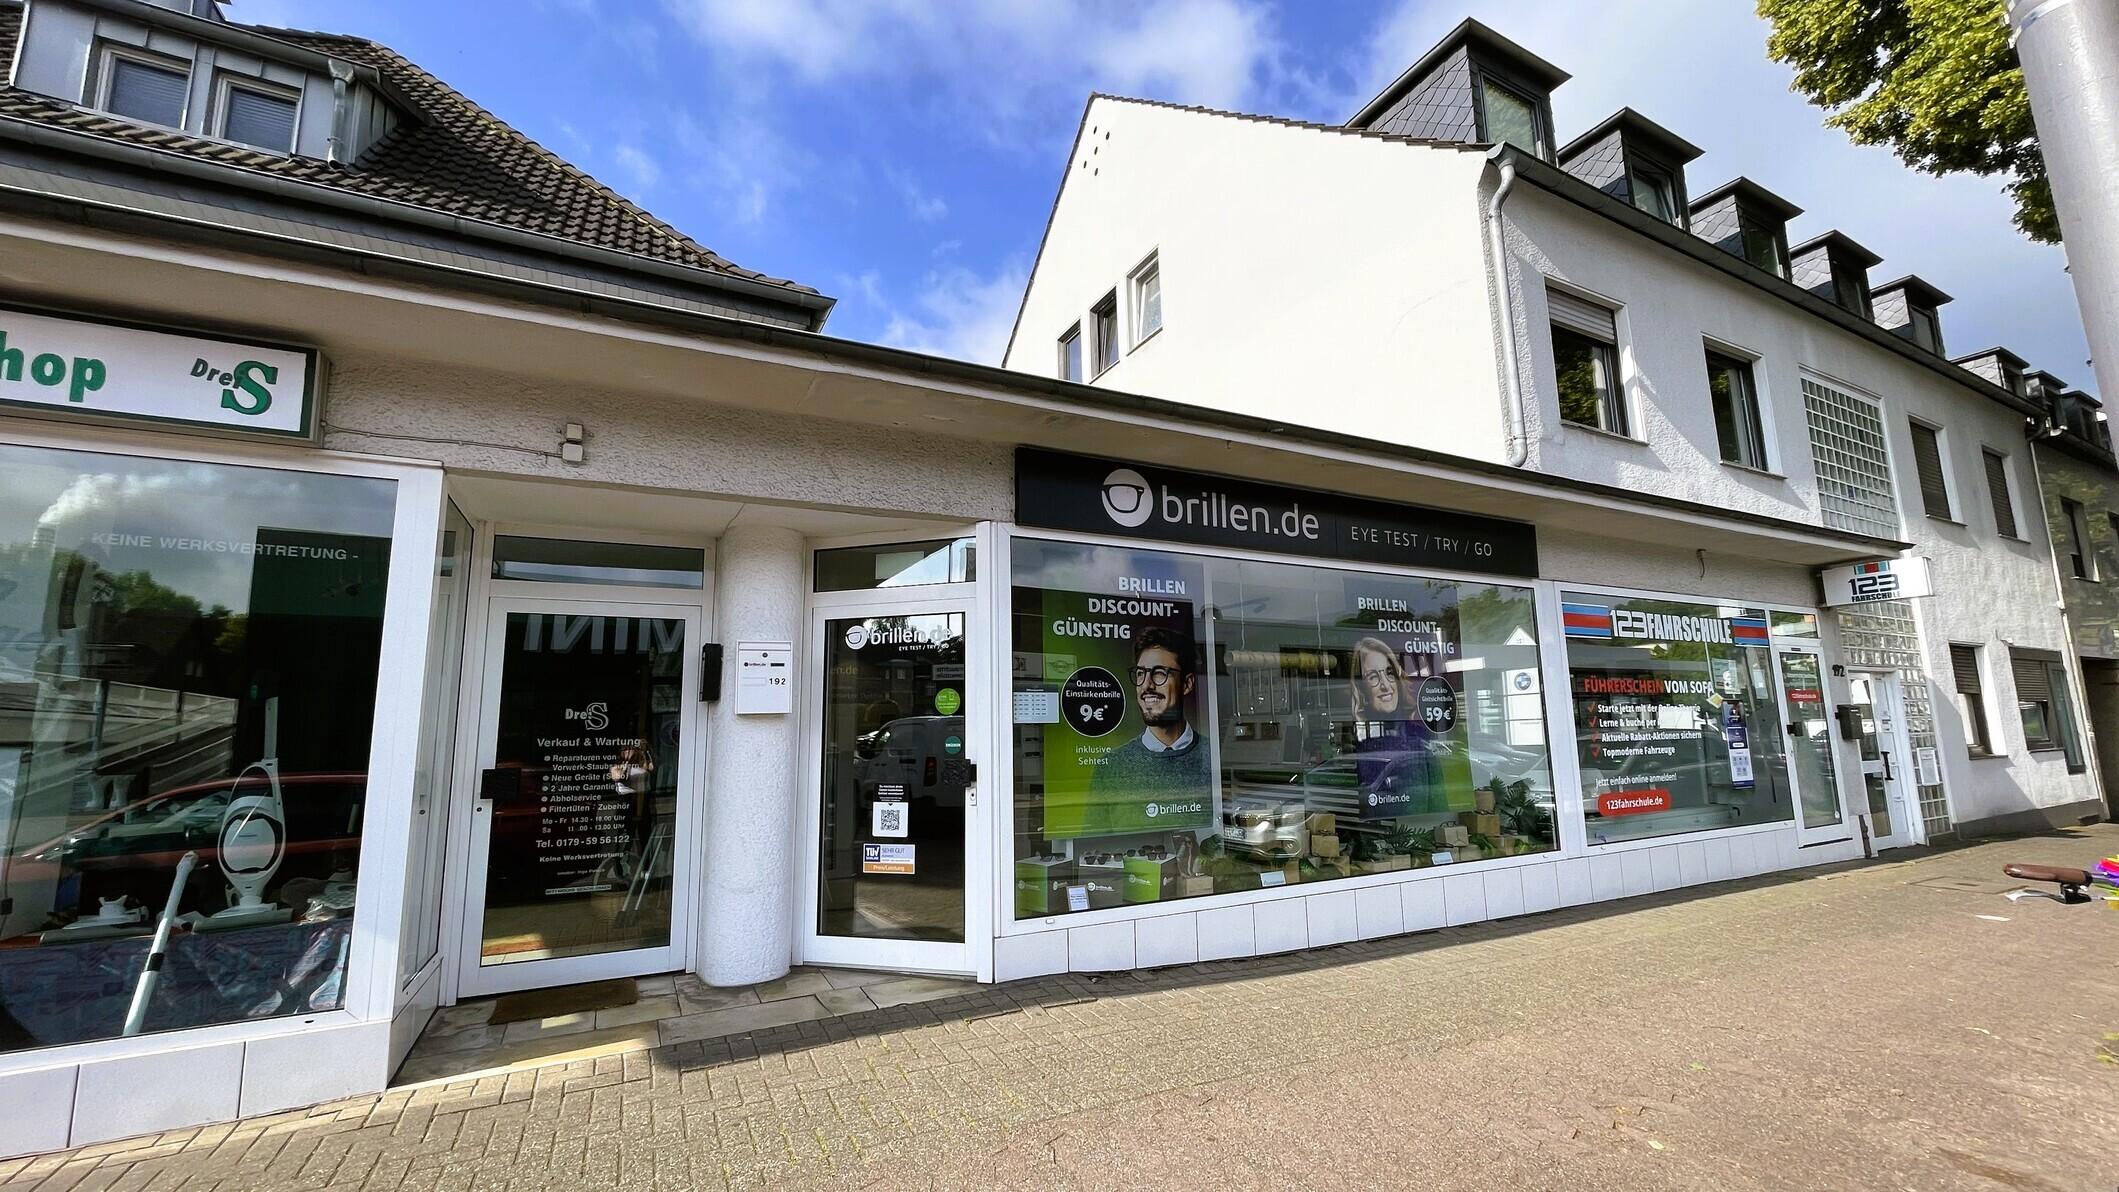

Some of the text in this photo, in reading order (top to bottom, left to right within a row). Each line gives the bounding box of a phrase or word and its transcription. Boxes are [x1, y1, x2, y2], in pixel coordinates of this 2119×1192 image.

[1161, 485, 1319, 540] brillen.de
[91, 531, 153, 548] KEINE
[160, 536, 348, 560] WERKSVERTRETUNG
[1351, 526, 1492, 557] EYE TEST / TRY / GO
[1118, 576, 1186, 595] BRILLEN
[1848, 573, 1900, 596] 123
[1088, 598, 1180, 617] DISCOUNT-
[1357, 597, 1407, 613] BRILLEN
[1052, 617, 1131, 639] GÜNSTIG
[1404, 637, 1455, 654] GÜNSTIG
[769, 678, 786, 686] 192
[1076, 680, 1111, 688] Qualitäts-
[1584, 675, 1665, 694] FÜHRERSCHEIN
[1664, 680, 1689, 694] VOM
[1065, 690, 1121, 699] Einstärkenbrille
[1597, 704, 1619, 712] Starte
[1635, 703, 1646, 712] mit
[1600, 719, 1619, 727] Lerne
[537, 737, 641, 747] Verkauf & Wartung
[1601, 731, 1702, 742] Aktuelle Rabatt-Aktionen sichern
[1075, 746, 1112, 754] inklusive
[1602, 745, 1676, 759] Topmoderne Fahrzeuge
[552, 754, 601, 762] Reparaturen
[1078, 757, 1109, 765] Sehtest
[551, 774, 572, 782] Neue
[574, 773, 600, 781] Geräte
[1610, 776, 1631, 786] einfach
[1631, 775, 1649, 784] online
[558, 784, 580, 792] Jahre
[550, 794, 602, 802] Abholservice
[1379, 792, 1410, 804] brillen.de
[1606, 795, 1663, 810] 123fahrschule.de
[549, 804, 590, 813] Filtertüten
[598, 803, 630, 811] Zubehör
[1160, 802, 1201, 814] brillen.de
[536, 839, 554, 848] Tel.
[599, 836, 611, 844] 56
[613, 835, 630, 843] 122
